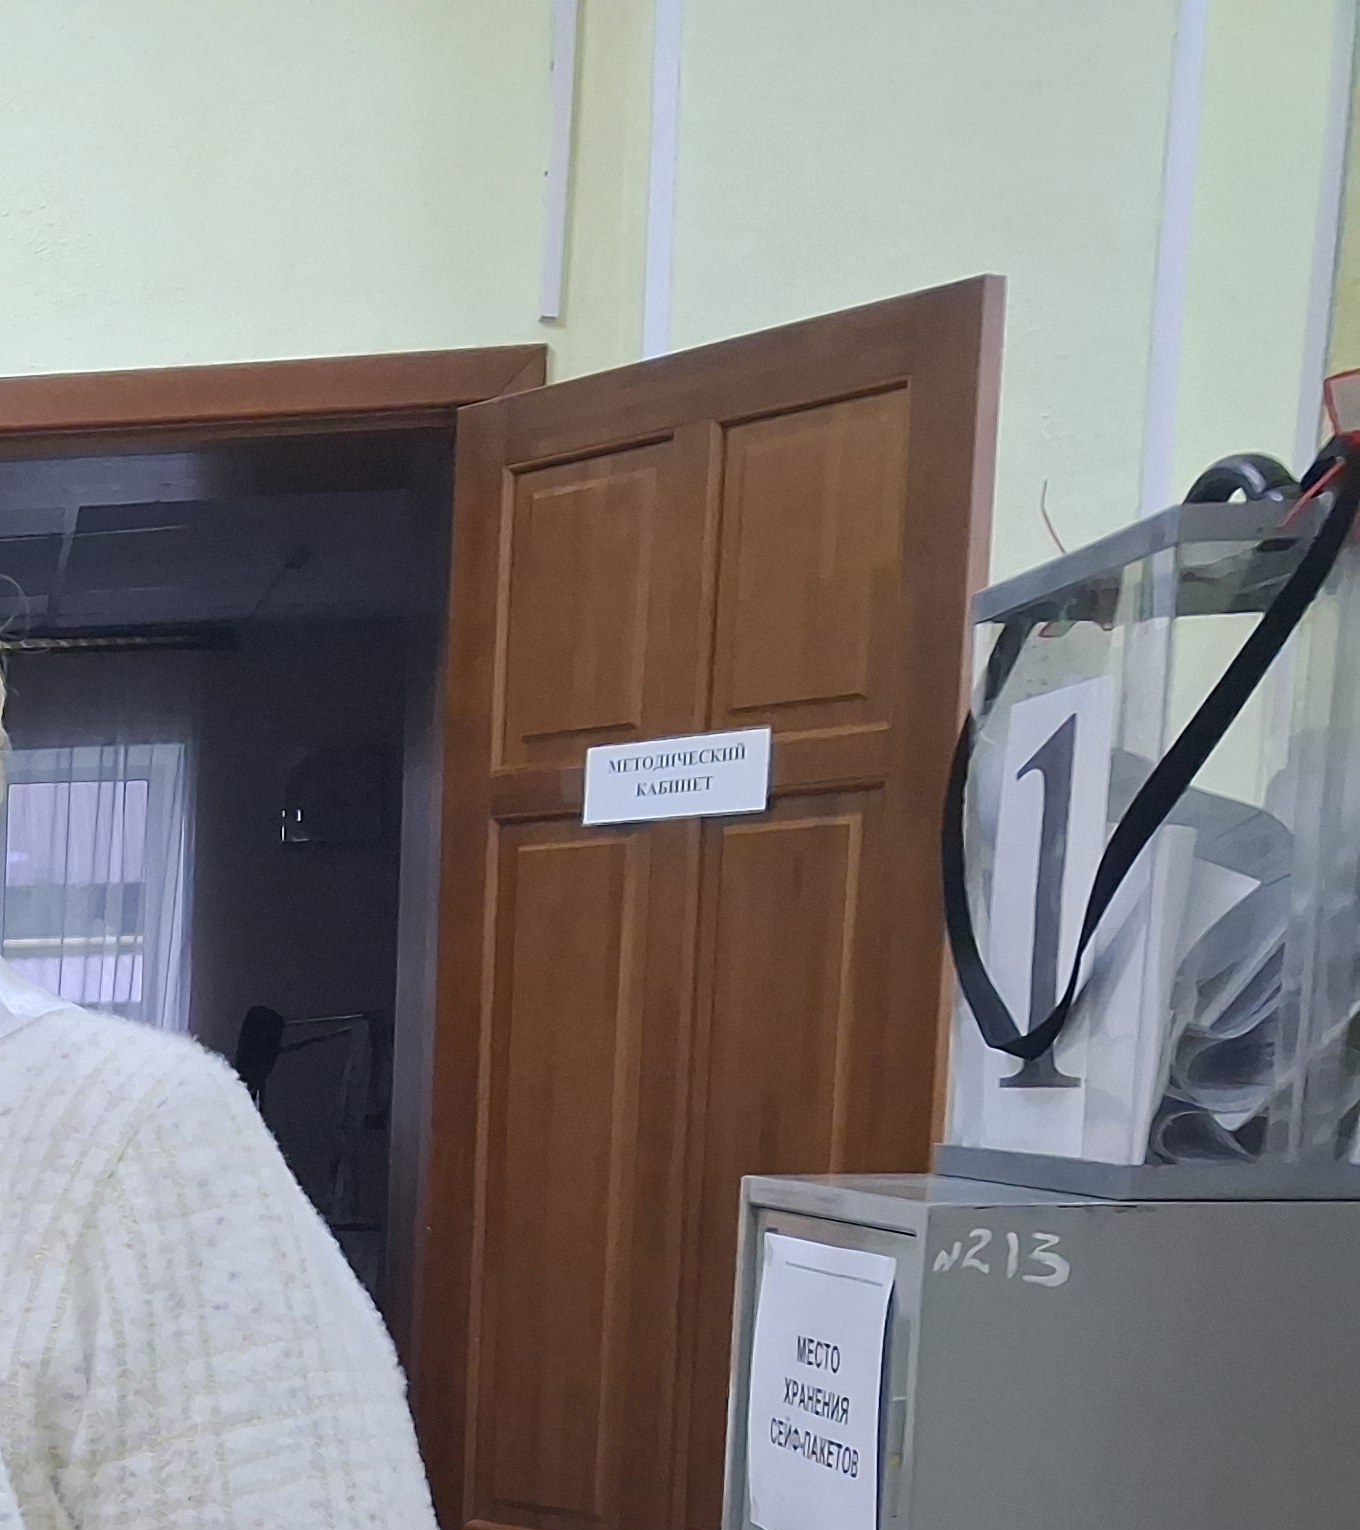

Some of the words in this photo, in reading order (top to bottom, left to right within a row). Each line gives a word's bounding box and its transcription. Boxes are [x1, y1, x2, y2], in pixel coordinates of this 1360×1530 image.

[608, 741, 746, 774] МЕТОДИЧЕСКИЙ
[636, 775, 713, 797] КАБИНЕТ
[999, 712, 1081, 1089] 1
[796, 1335, 841, 1375] МЕСТО
[784, 1376, 850, 1426] ХРАНЕНИЯ
[770, 1416, 859, 1479] СЕЙФ-ПАКЕТОВ
